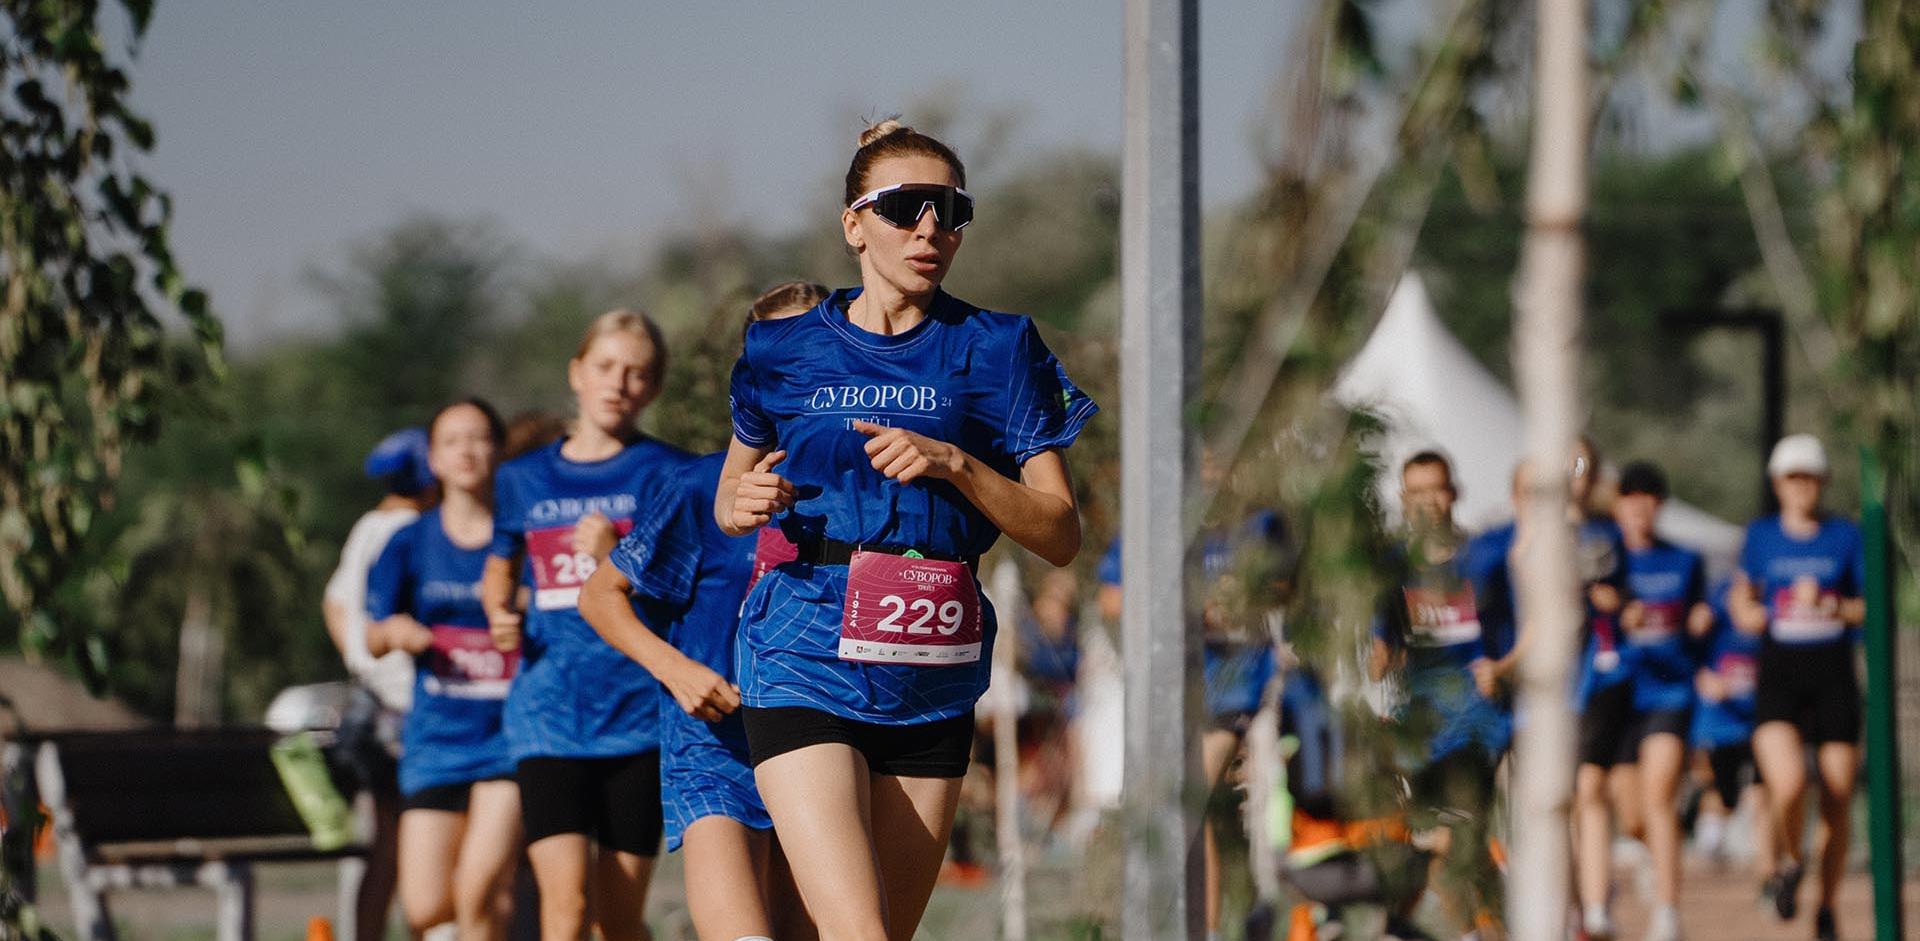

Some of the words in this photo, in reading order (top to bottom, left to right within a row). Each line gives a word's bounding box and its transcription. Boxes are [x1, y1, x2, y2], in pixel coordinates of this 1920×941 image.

[811, 385, 937, 411] СУВОРОВ
[903, 569, 952, 585] СУВОРОВ
[849, 591, 859, 628] 1924
[877, 595, 964, 635] 229
